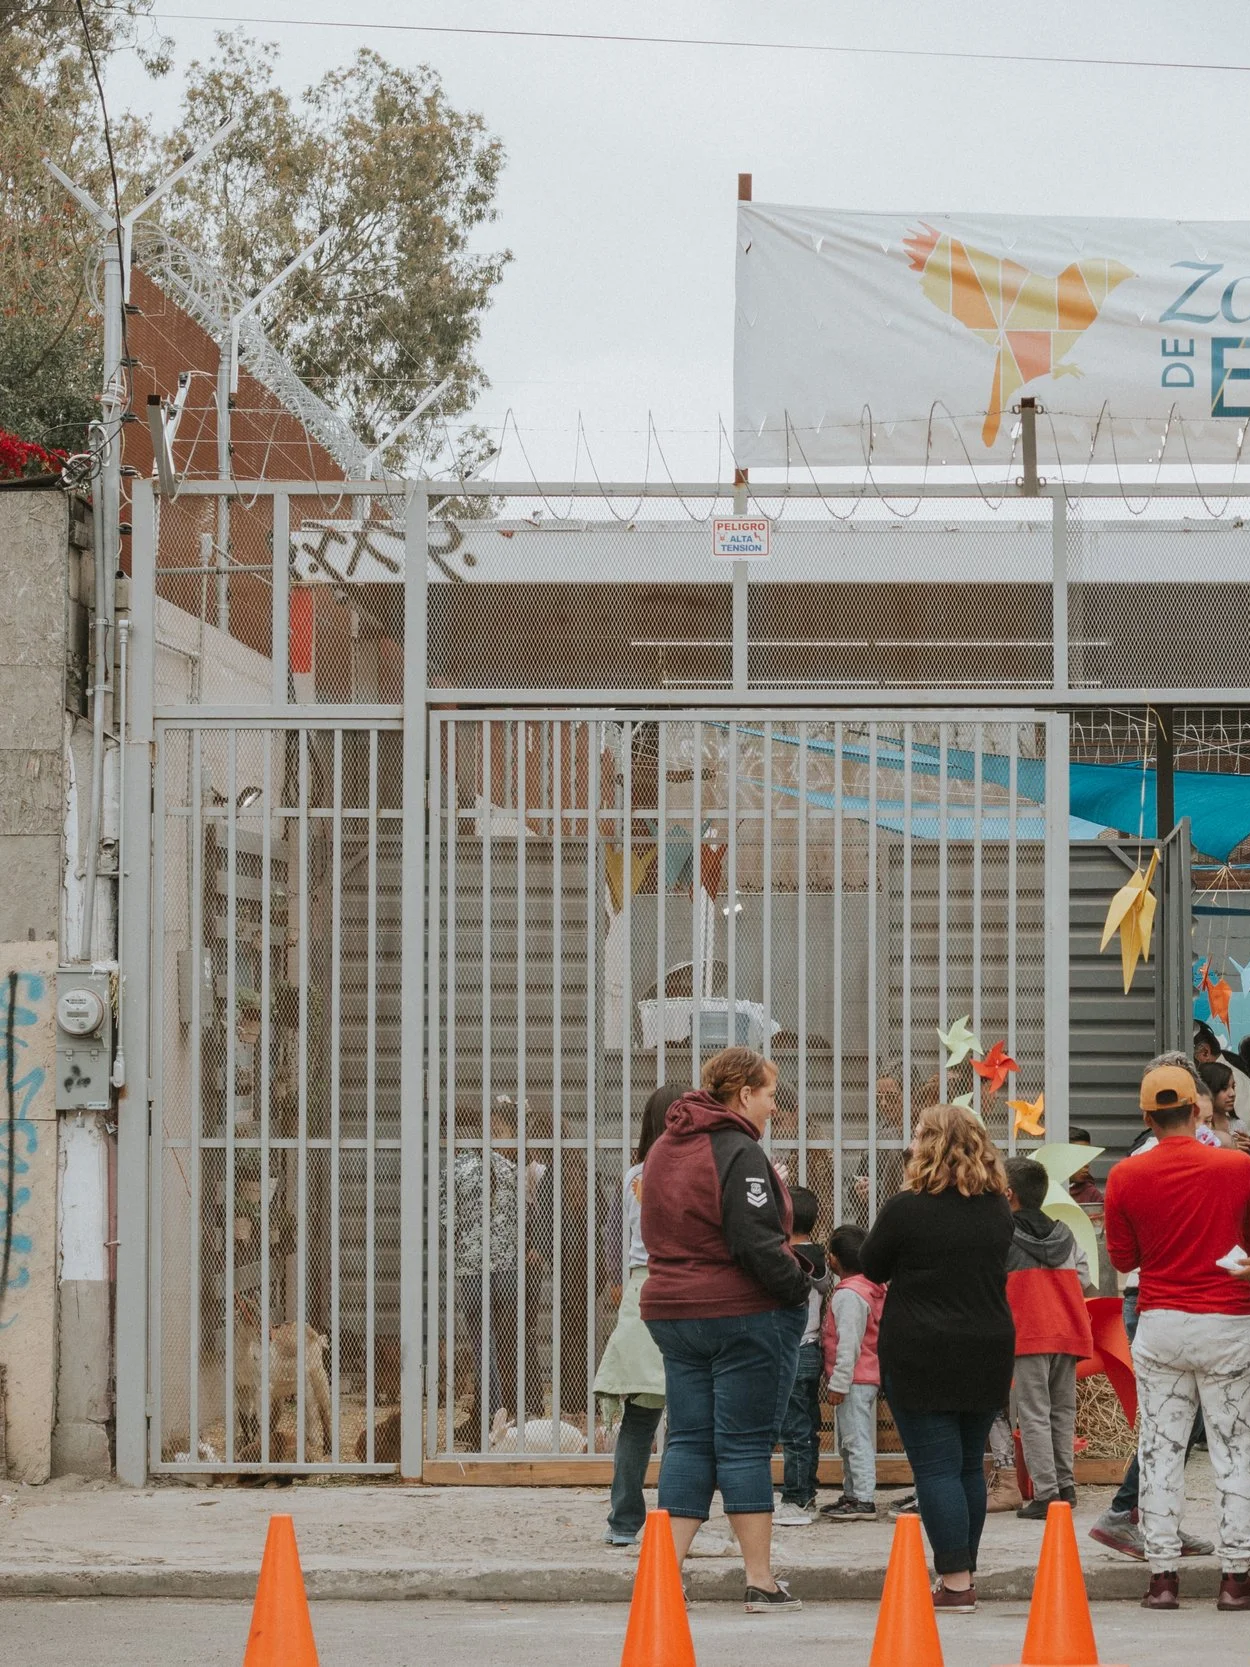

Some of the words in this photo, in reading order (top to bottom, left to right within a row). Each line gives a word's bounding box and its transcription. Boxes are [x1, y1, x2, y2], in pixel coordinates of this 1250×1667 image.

[1161, 338, 1194, 388] DE
[717, 522, 766, 531] PELIGRO
[730, 535, 753, 543] ALTA
[721, 544, 762, 552] TENSION
